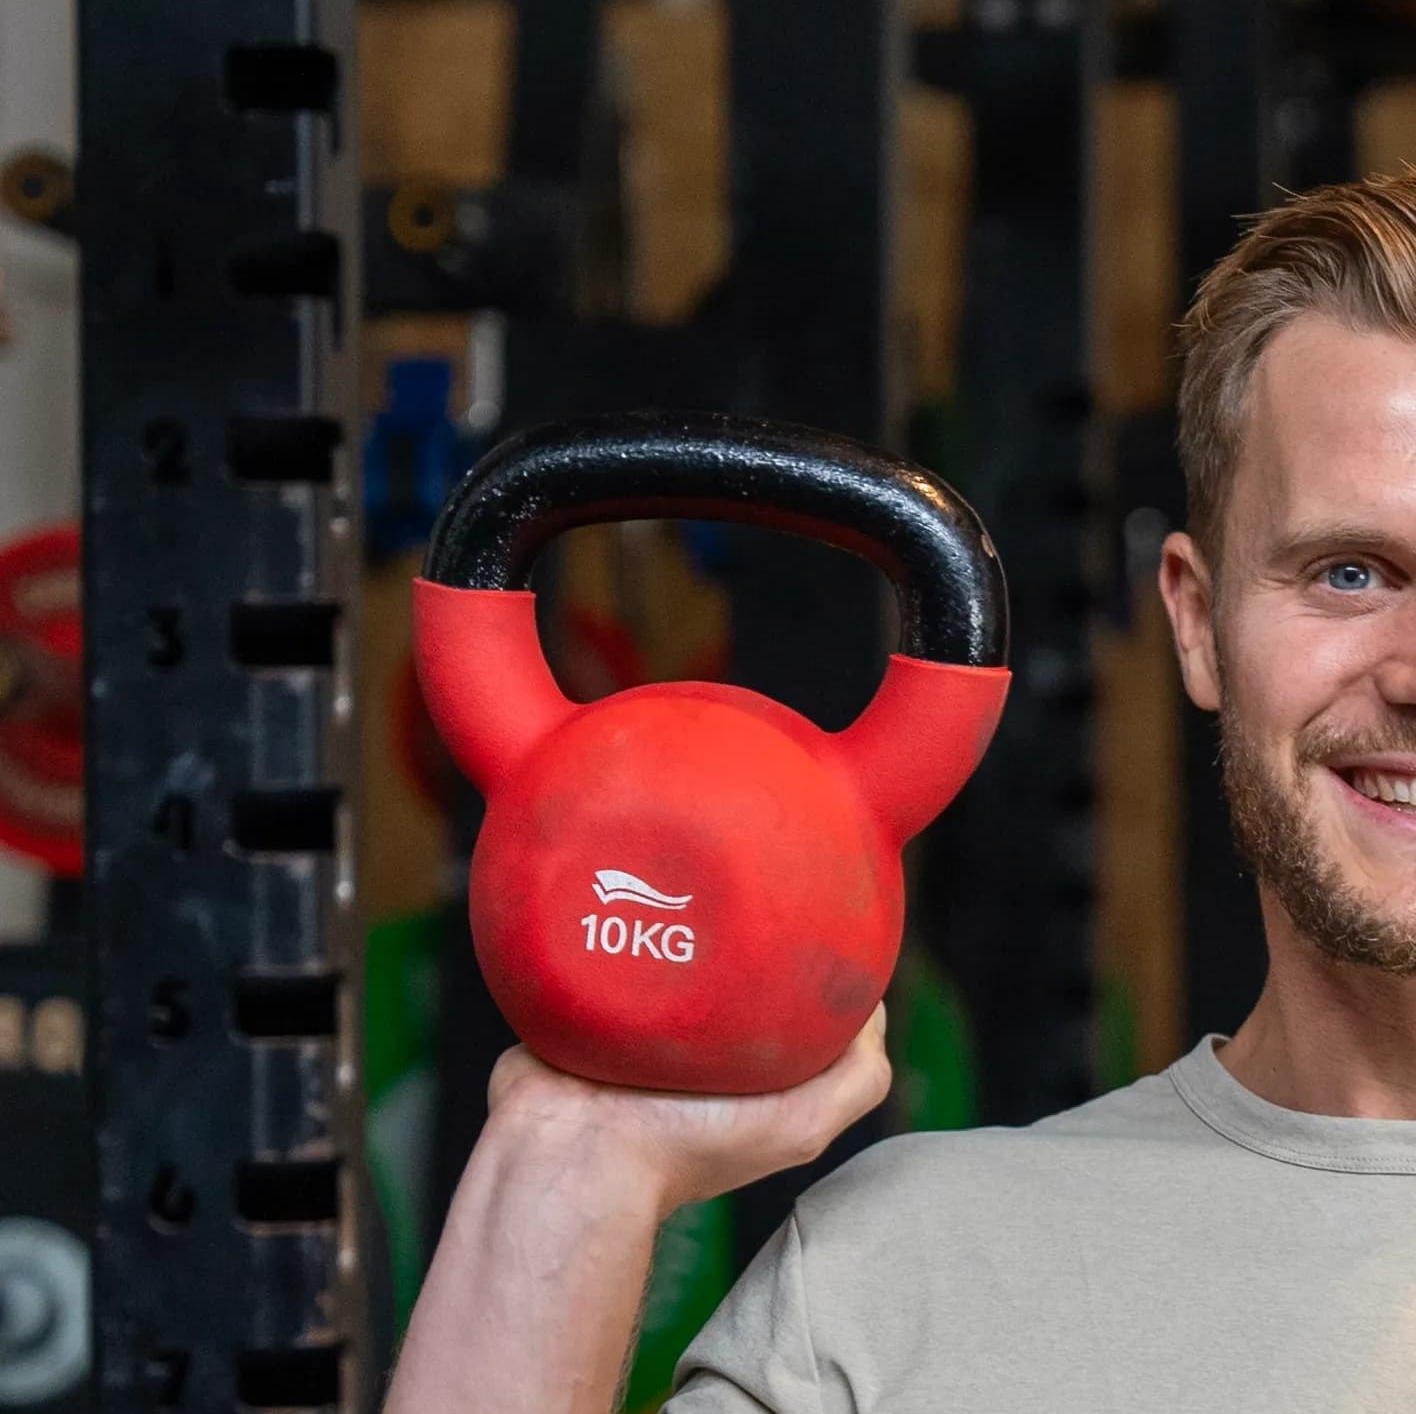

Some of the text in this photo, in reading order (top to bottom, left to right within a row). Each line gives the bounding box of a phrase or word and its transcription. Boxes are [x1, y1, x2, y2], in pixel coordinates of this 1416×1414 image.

[143, 417, 190, 487] 2
[147, 605, 186, 669] 3
[581, 913, 695, 963] 10KG
